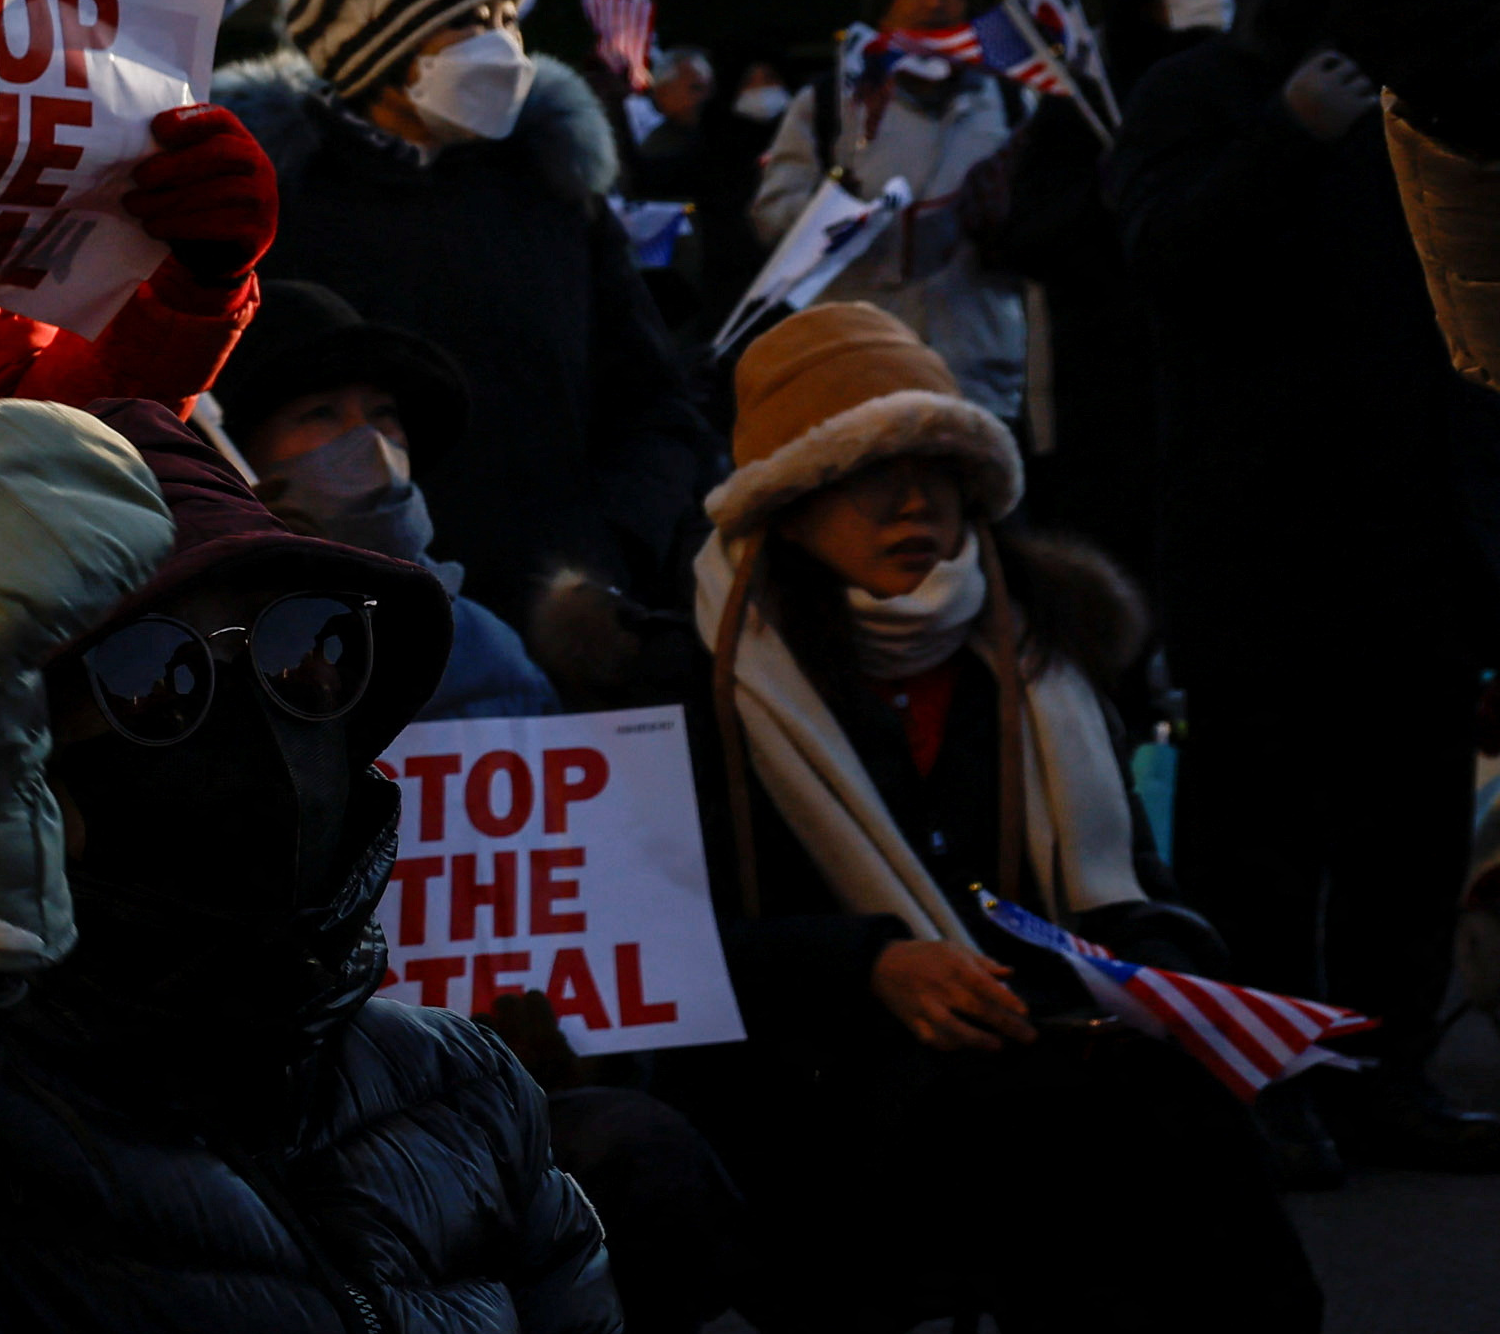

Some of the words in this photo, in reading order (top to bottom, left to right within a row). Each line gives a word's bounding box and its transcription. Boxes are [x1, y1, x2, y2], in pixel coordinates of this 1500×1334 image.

[373, 748, 609, 841] TOP
[390, 848, 586, 946] THE
[378, 942, 677, 1029] TEAL
